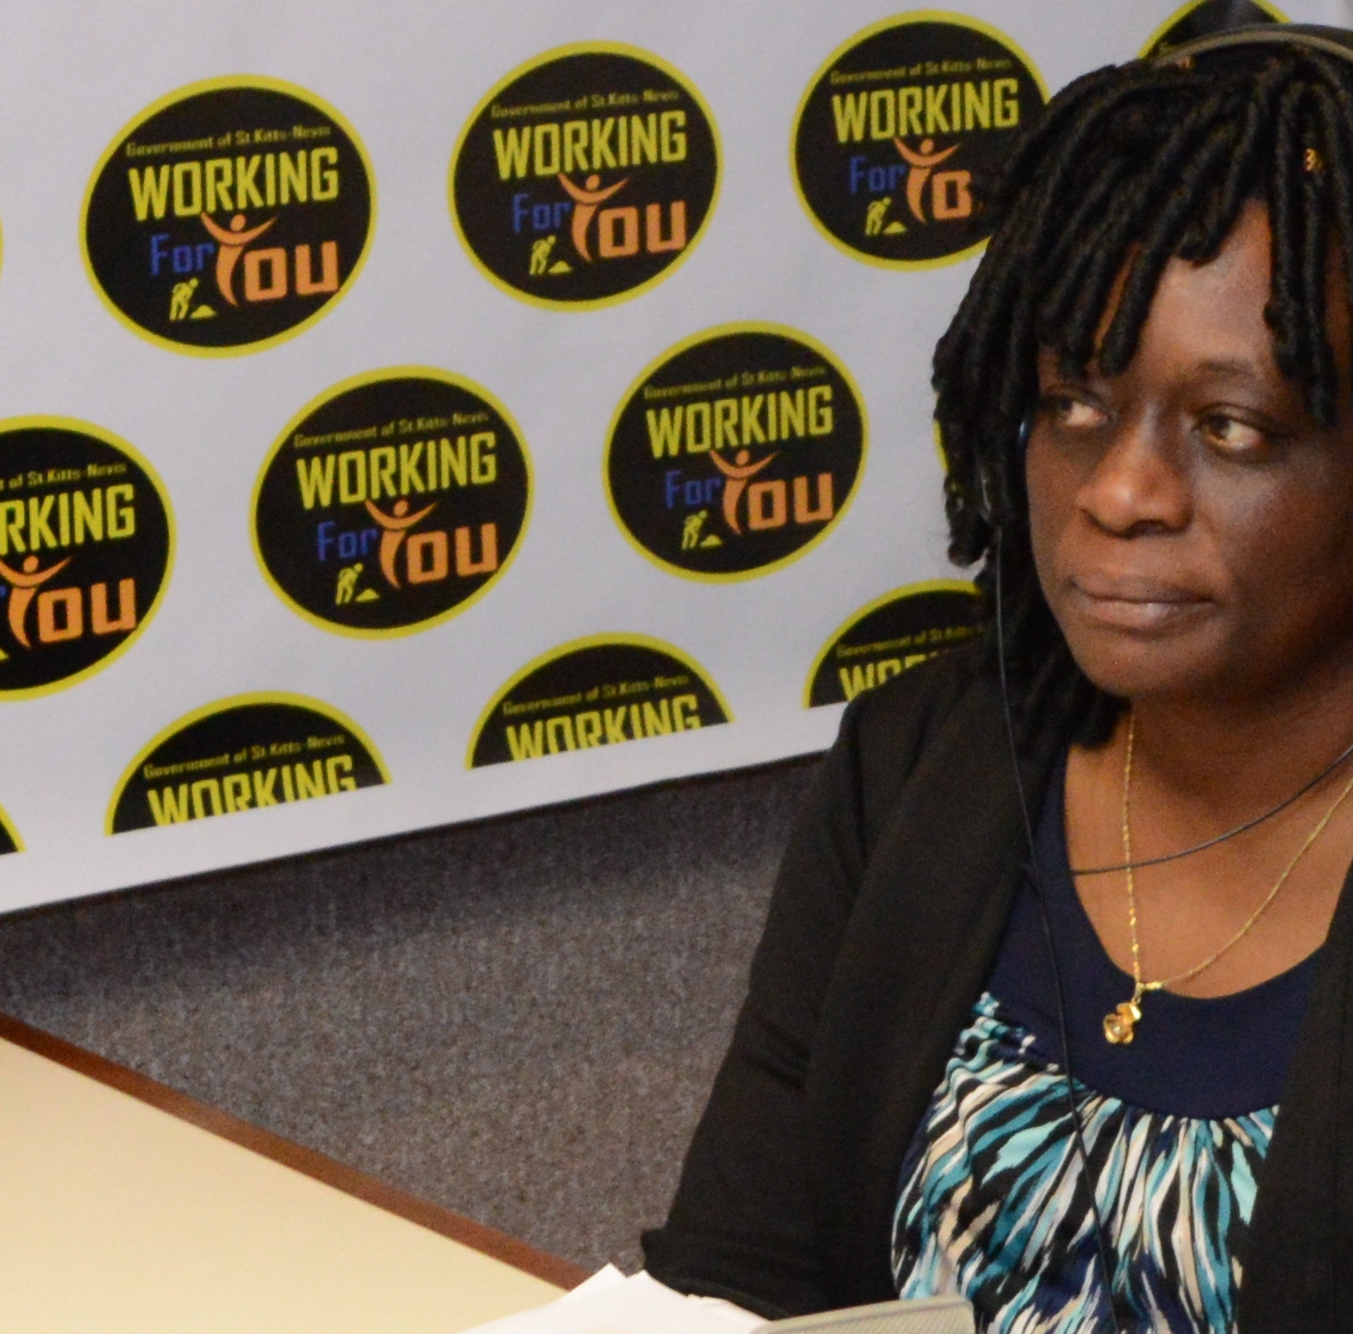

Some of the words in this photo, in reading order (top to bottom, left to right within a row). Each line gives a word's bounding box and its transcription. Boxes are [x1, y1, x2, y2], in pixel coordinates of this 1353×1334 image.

[831, 77, 1018, 144] WORKING
[493, 110, 686, 181] WORKING
[128, 146, 338, 223] WORKING
[848, 154, 907, 194] For
[511, 192, 573, 233] For
[149, 233, 216, 277] For
[646, 385, 833, 460] WORKING
[296, 431, 496, 511] WORKING
[663, 469, 723, 509] For
[316, 520, 380, 563] For
